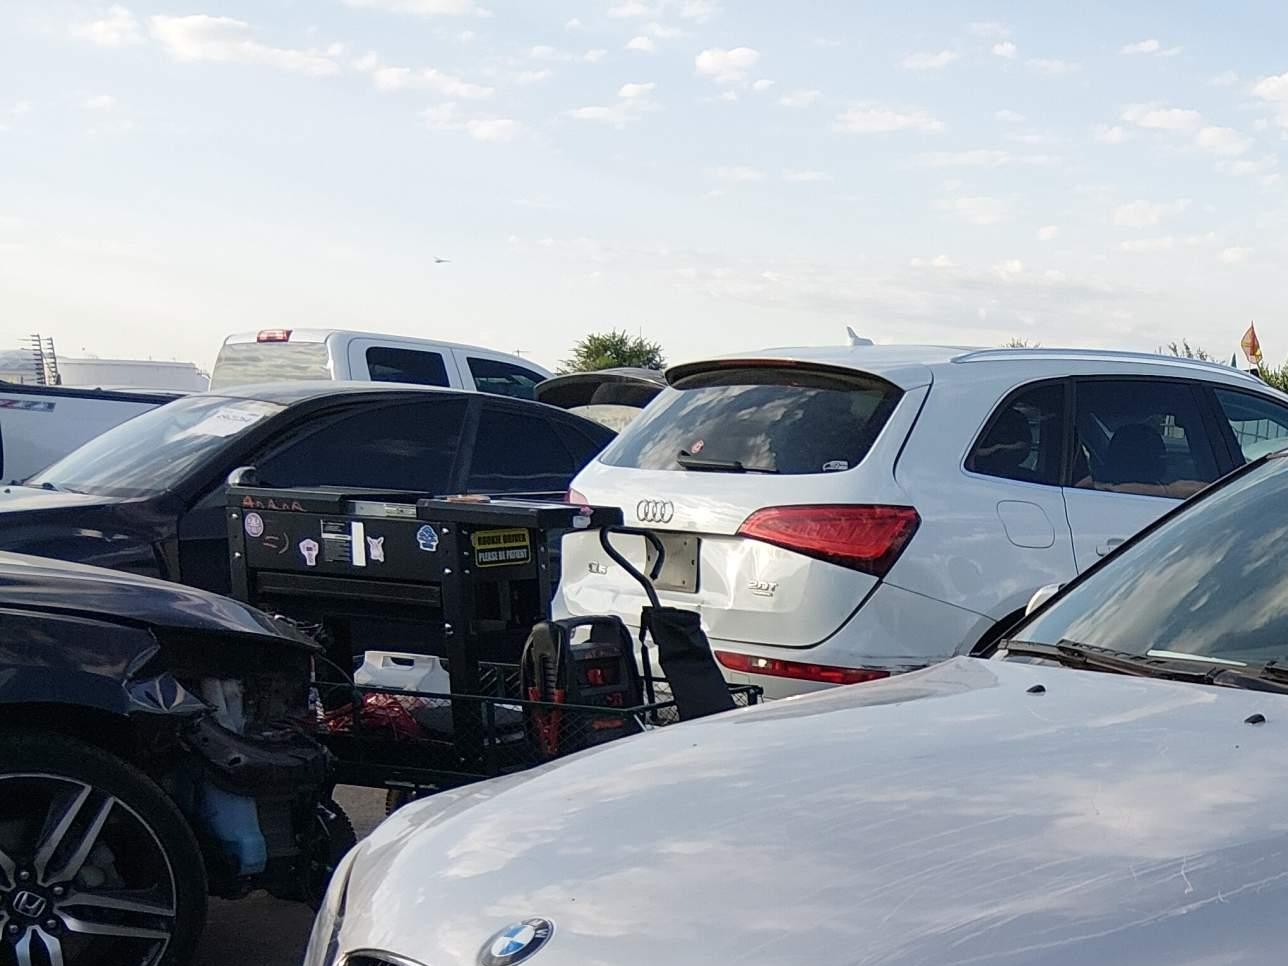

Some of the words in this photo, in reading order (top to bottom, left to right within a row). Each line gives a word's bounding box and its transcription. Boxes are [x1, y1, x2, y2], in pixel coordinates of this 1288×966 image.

[478, 551, 498, 563] PLEASE
[498, 550, 506, 561] BE
[506, 548, 528, 560] PATIENT
